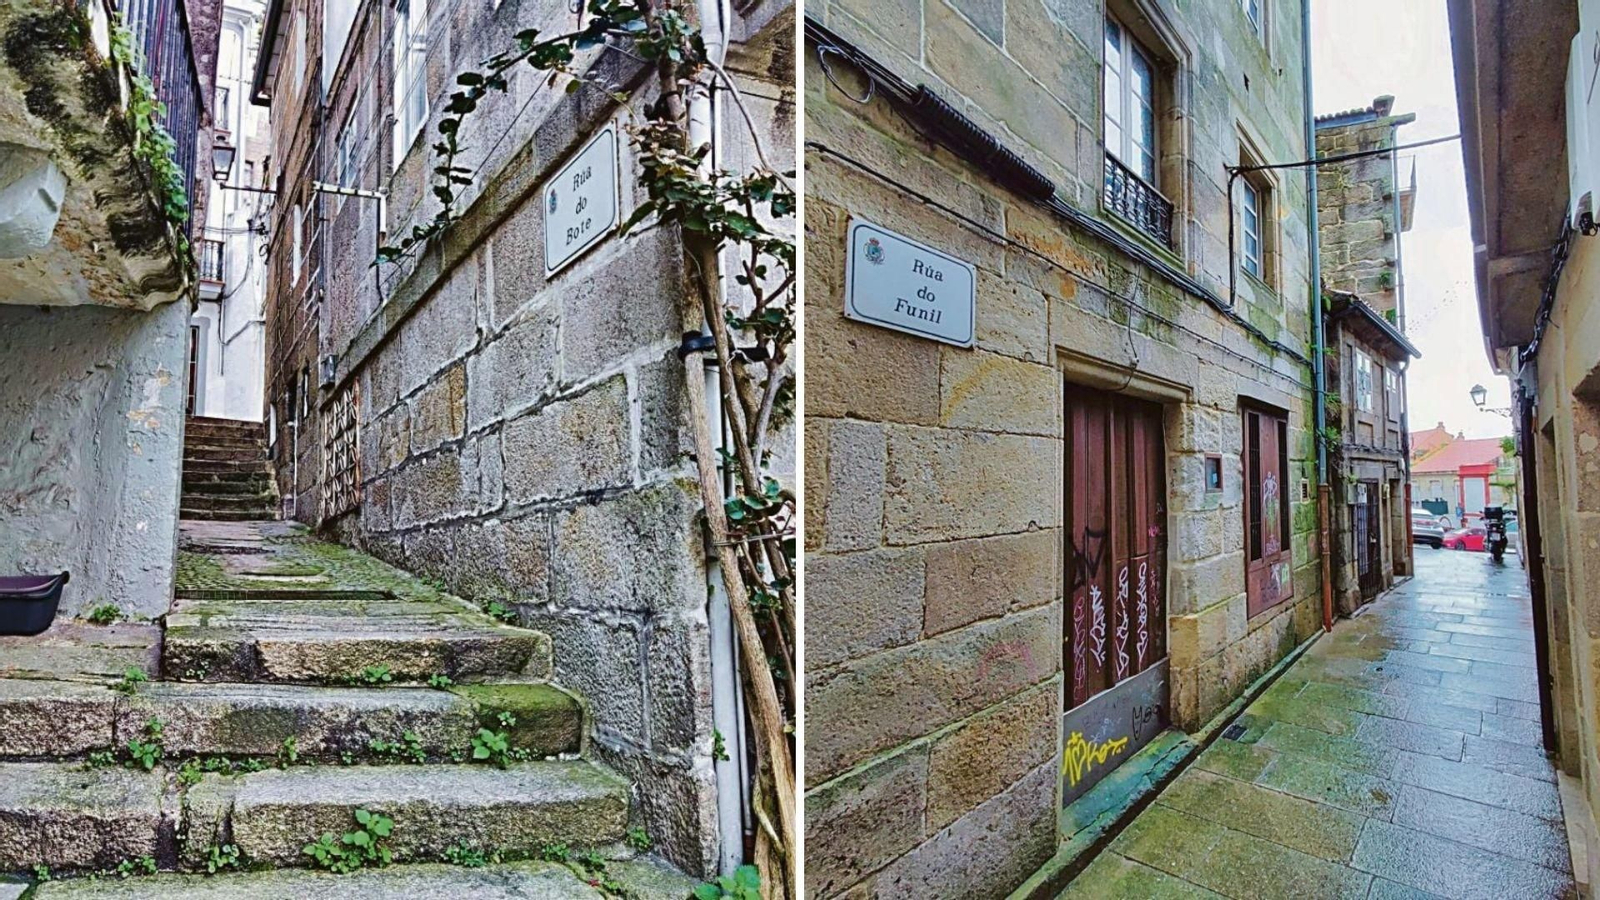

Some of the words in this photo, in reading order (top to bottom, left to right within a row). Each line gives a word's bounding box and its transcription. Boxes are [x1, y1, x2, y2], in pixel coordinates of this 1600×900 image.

[575, 196, 588, 215] do
[566, 217, 592, 246] Bote
[912, 259, 943, 282] Rúa
[916, 286, 936, 302] do
[894, 297, 942, 324] Funil
